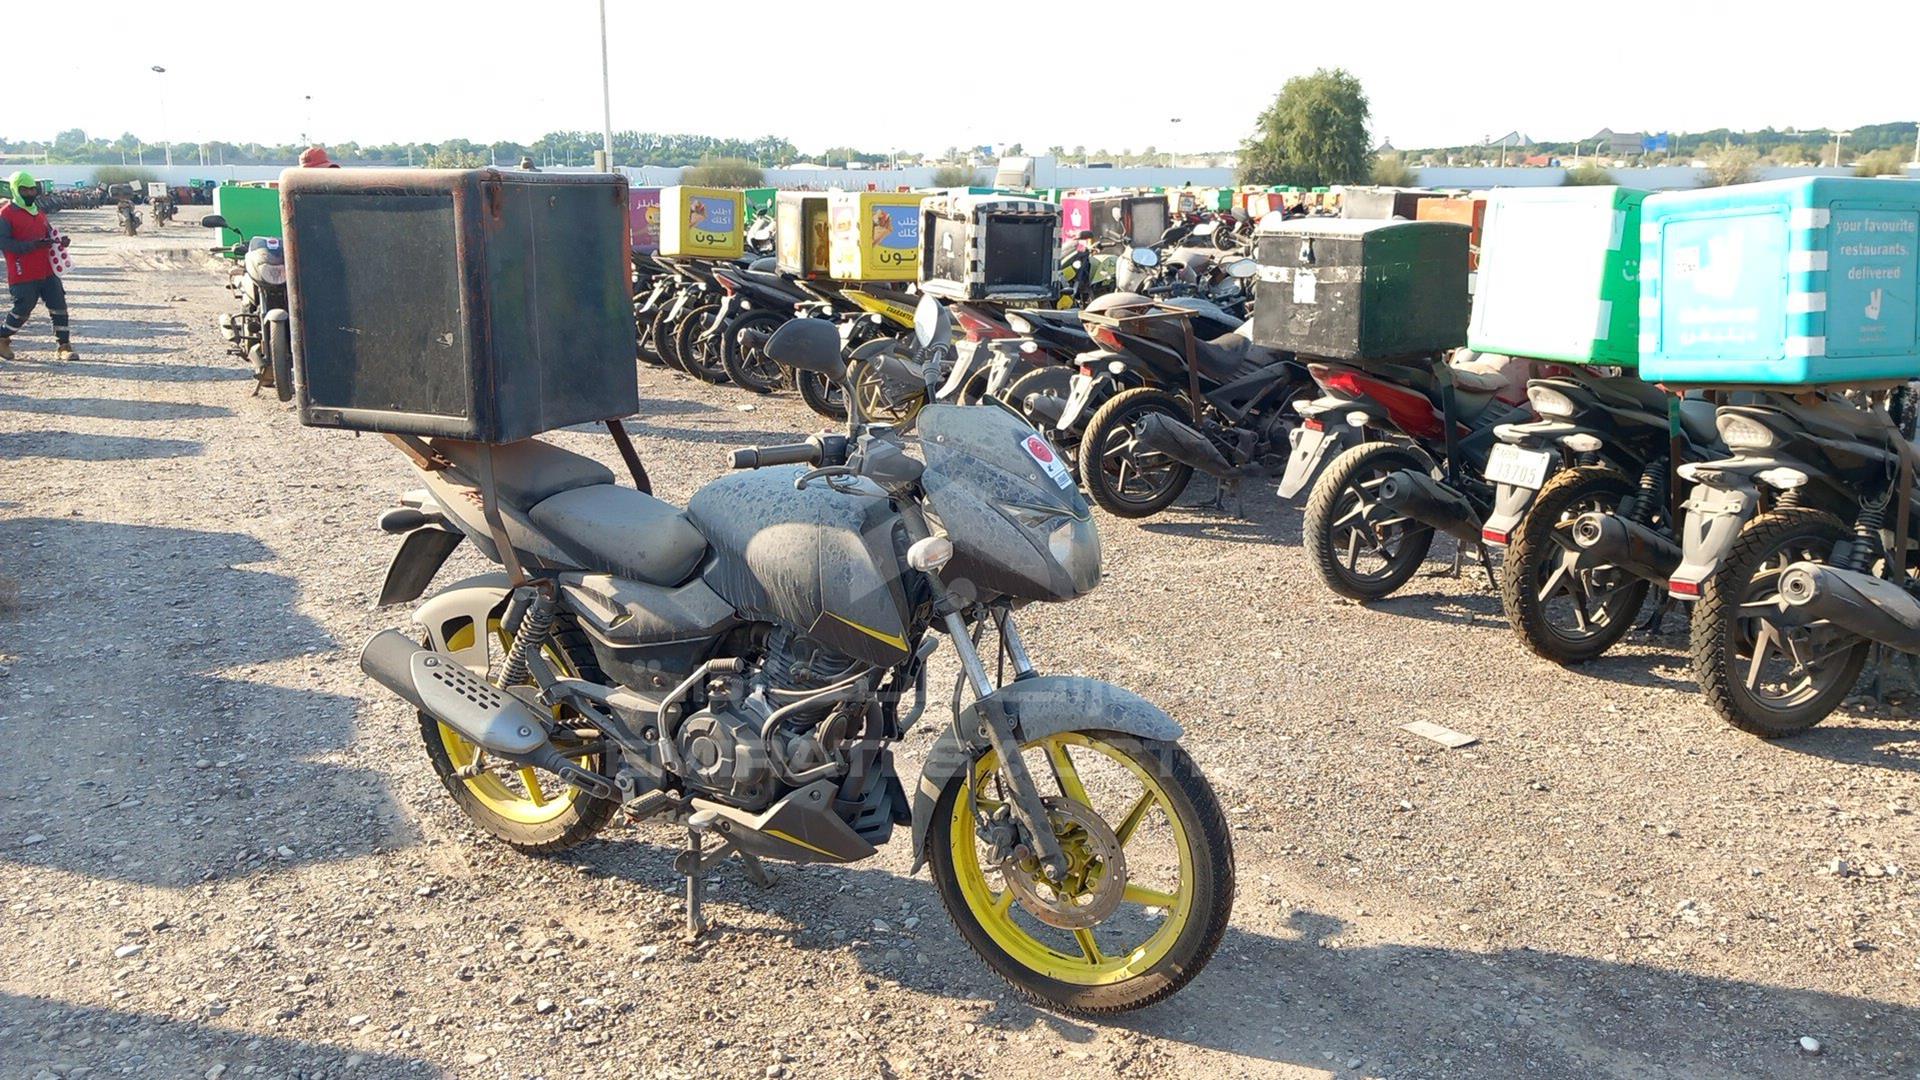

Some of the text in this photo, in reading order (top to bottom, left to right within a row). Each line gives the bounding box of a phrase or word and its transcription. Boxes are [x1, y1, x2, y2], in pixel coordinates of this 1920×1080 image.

[897, 217, 917, 226] طلب
[1836, 217, 1915, 235] your favourite
[897, 227, 917, 238] كلك
[1848, 265, 1901, 280] delivered
